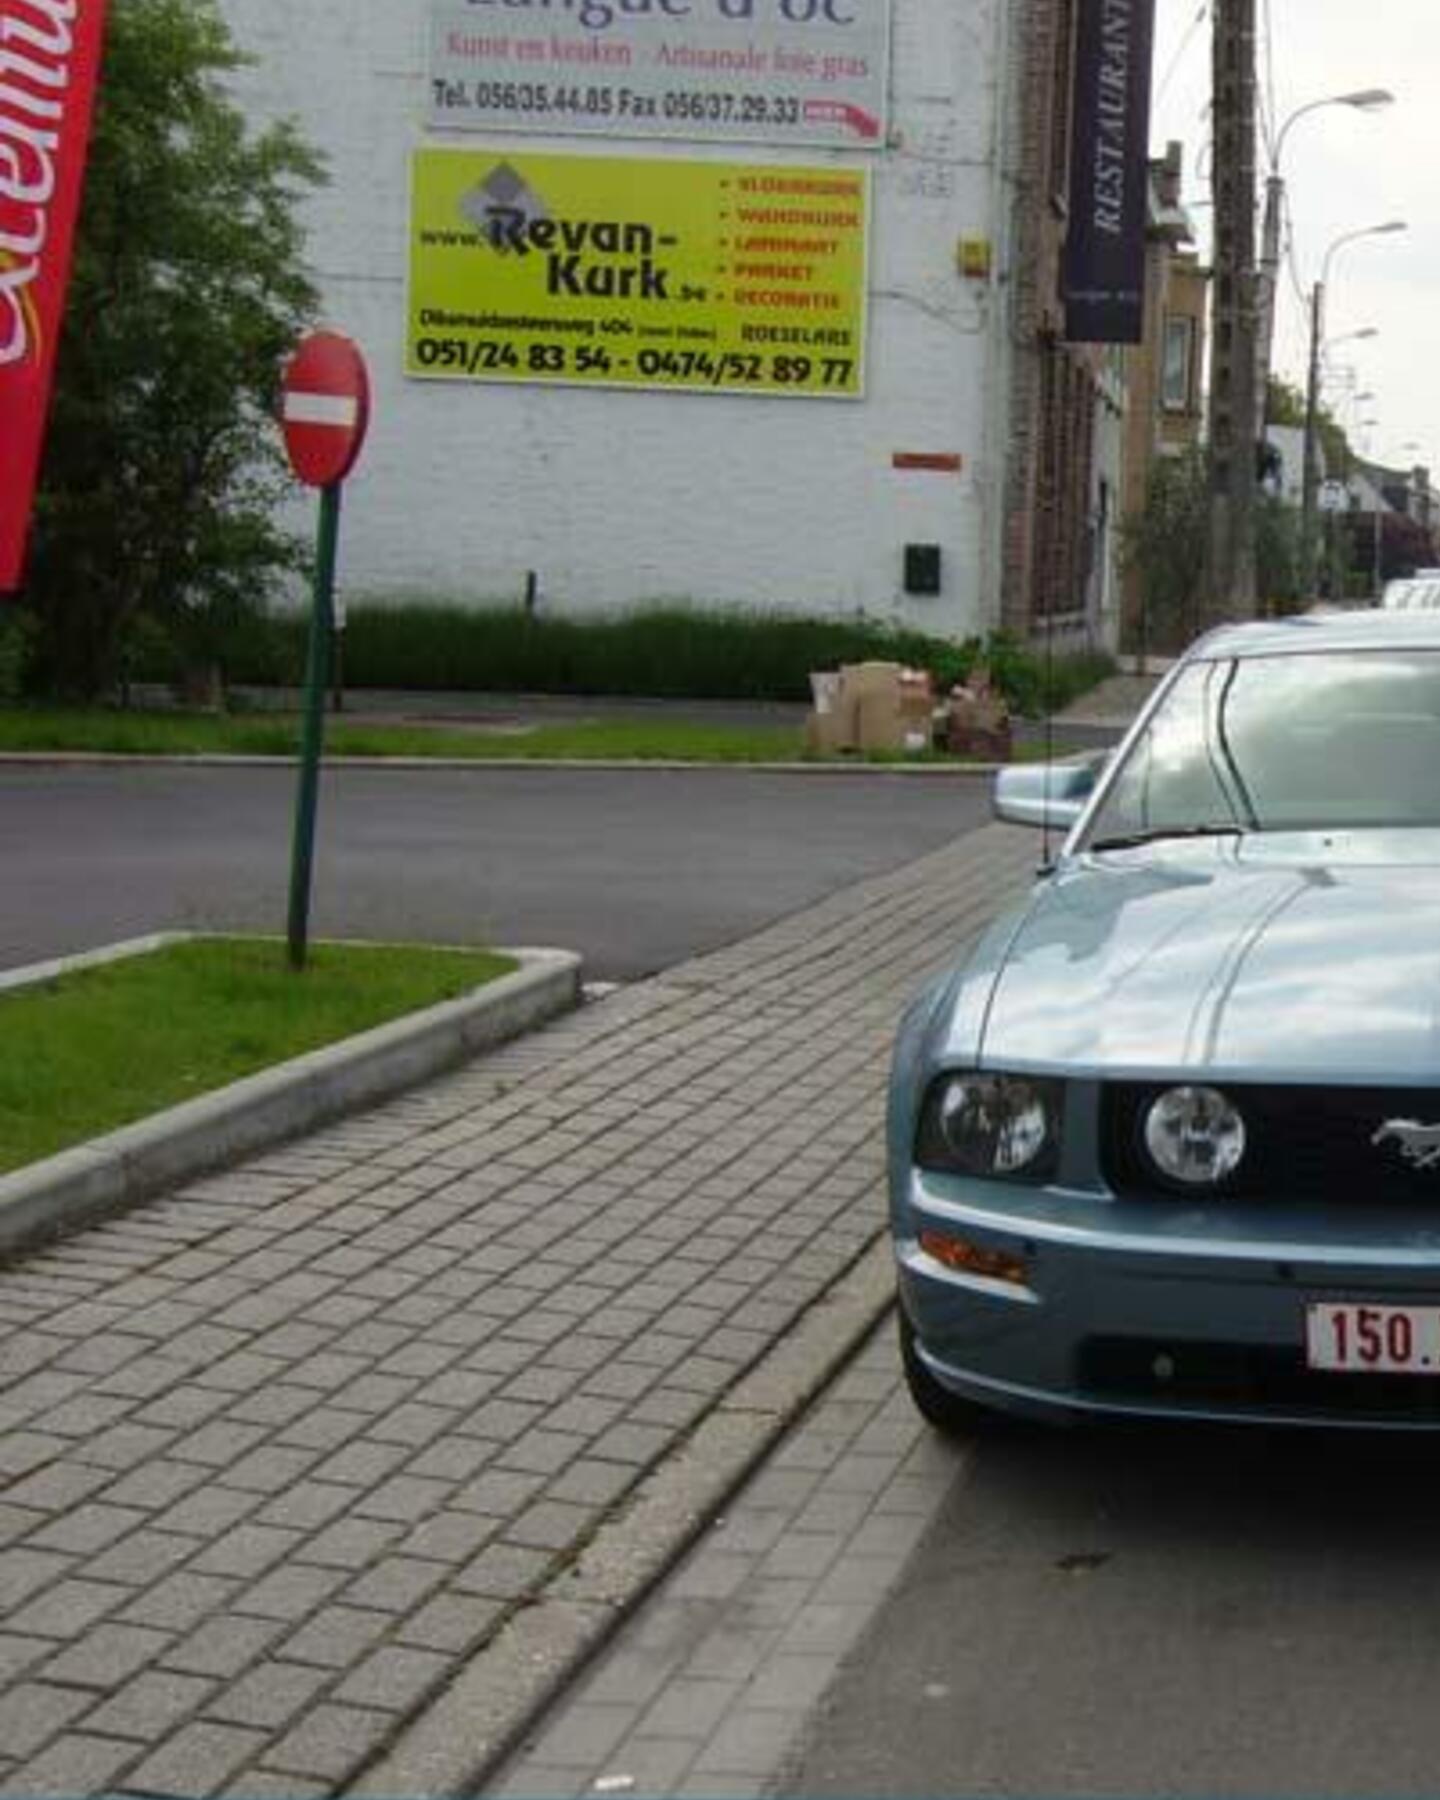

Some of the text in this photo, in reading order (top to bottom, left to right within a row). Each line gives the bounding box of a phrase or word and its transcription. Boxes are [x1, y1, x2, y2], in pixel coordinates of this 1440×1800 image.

[433, 79, 471, 108] Tel.
[618, 88, 656, 116] Fax
[546, 252, 668, 299] Kurk
[416, 337, 519, 375] 051/24
[528, 342, 565, 371] 83
[575, 344, 610, 373] 54
[637, 347, 762, 386] 0474/52
[772, 355, 811, 383] 89
[820, 358, 853, 386] 77
